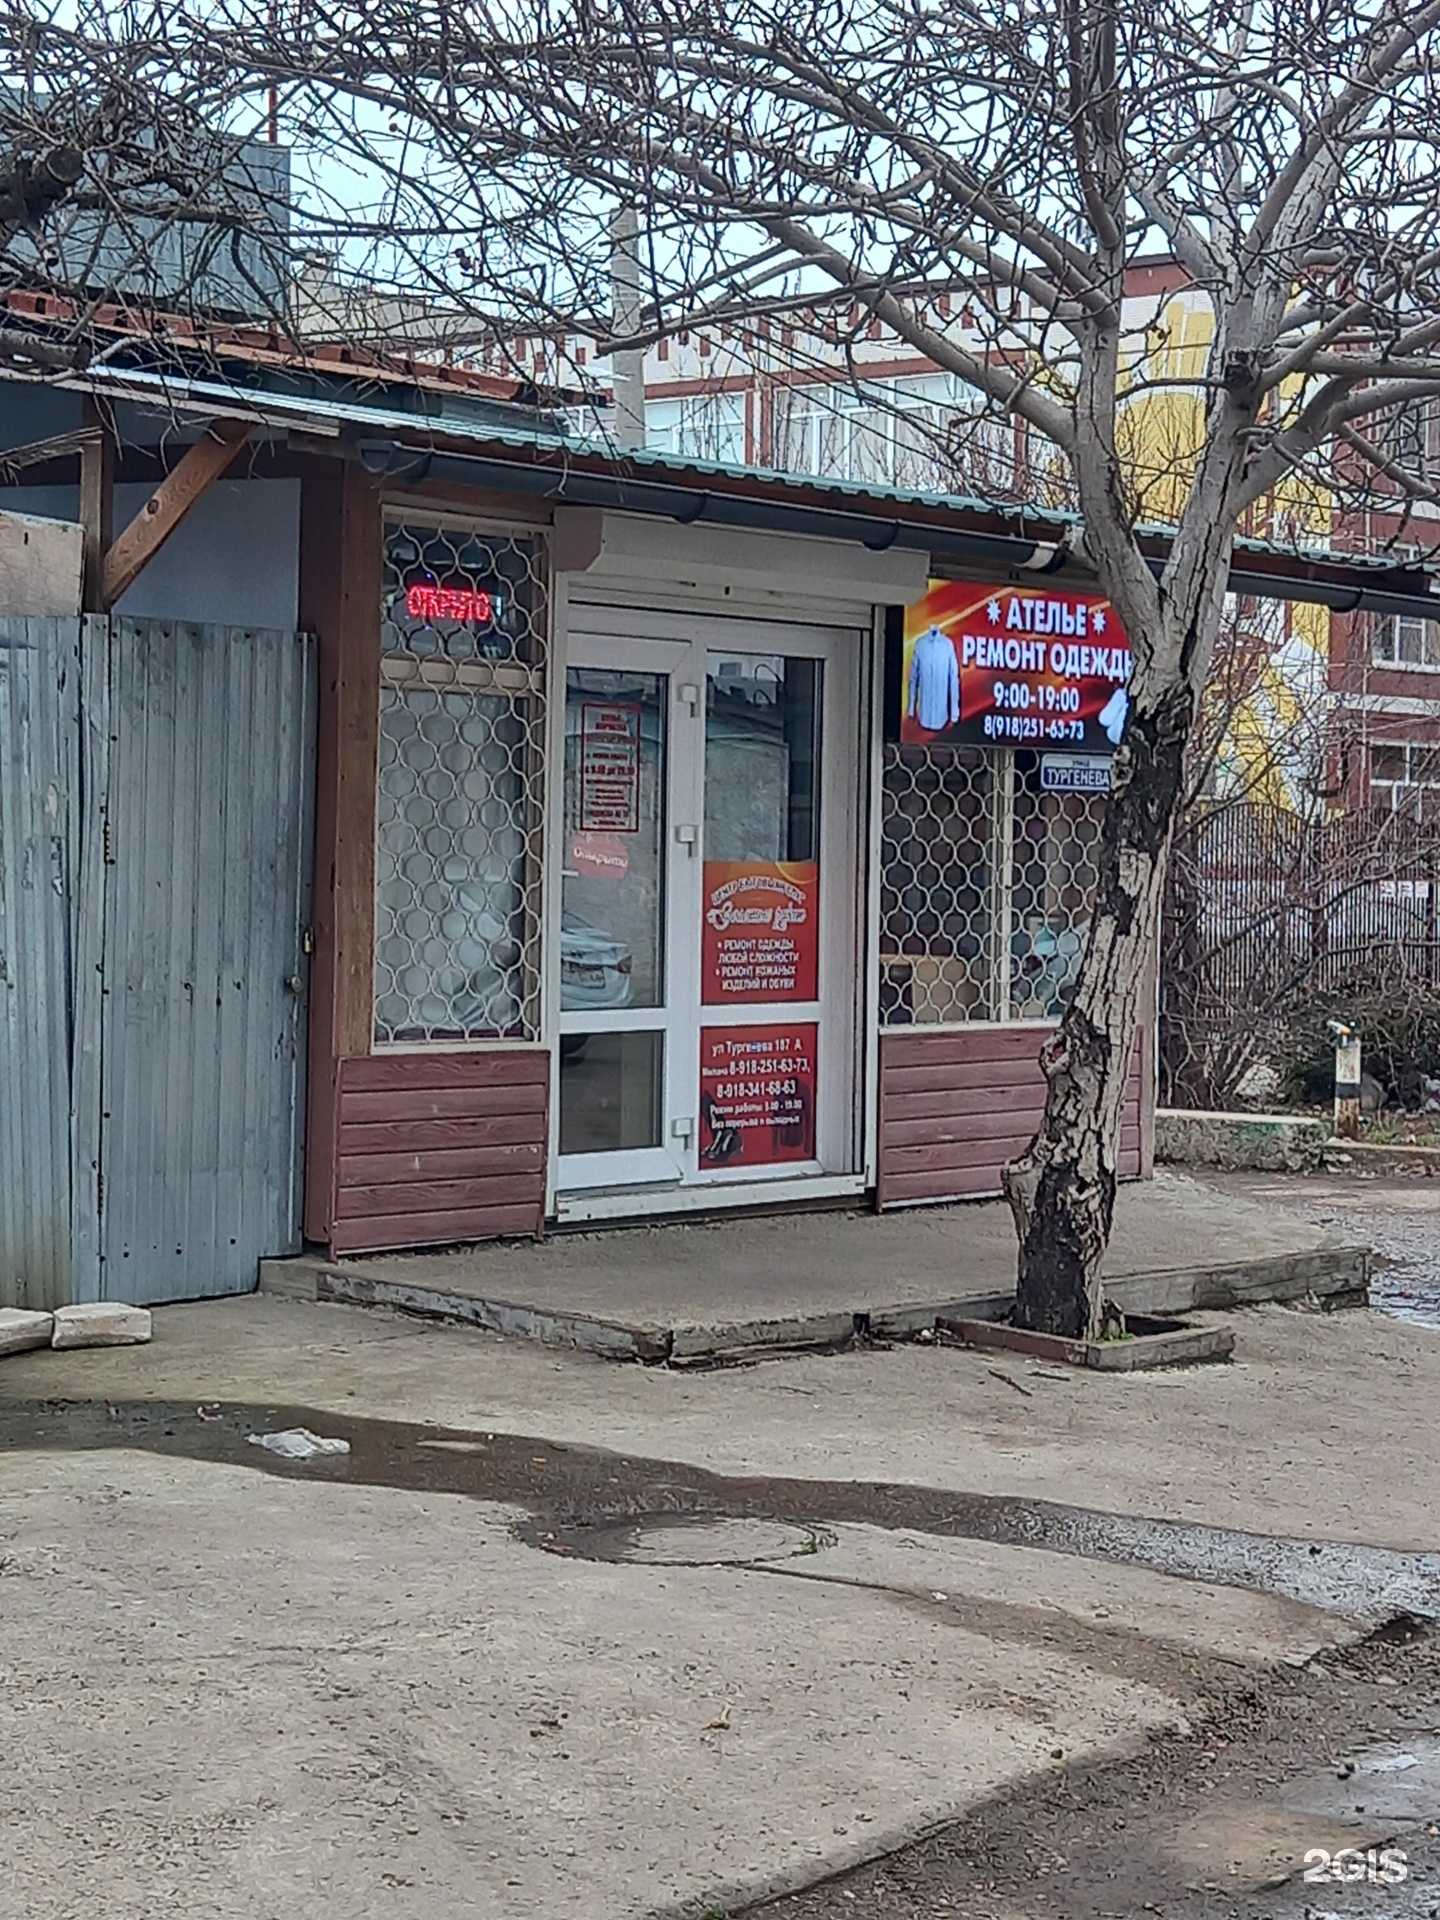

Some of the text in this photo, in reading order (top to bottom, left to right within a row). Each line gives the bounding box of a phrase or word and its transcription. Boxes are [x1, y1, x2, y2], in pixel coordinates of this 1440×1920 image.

[1006, 597, 1088, 636] АТЕЛЬЕ
[962, 635, 1047, 672] РЕМОНТ
[984, 715, 1085, 741] 8(918)251-63-73
[1047, 768, 1110, 785] ТУРГЕНЕВА
[724, 939, 756, 951] РЕМОНТ
[721, 965, 753, 977] РЕМОНТ
